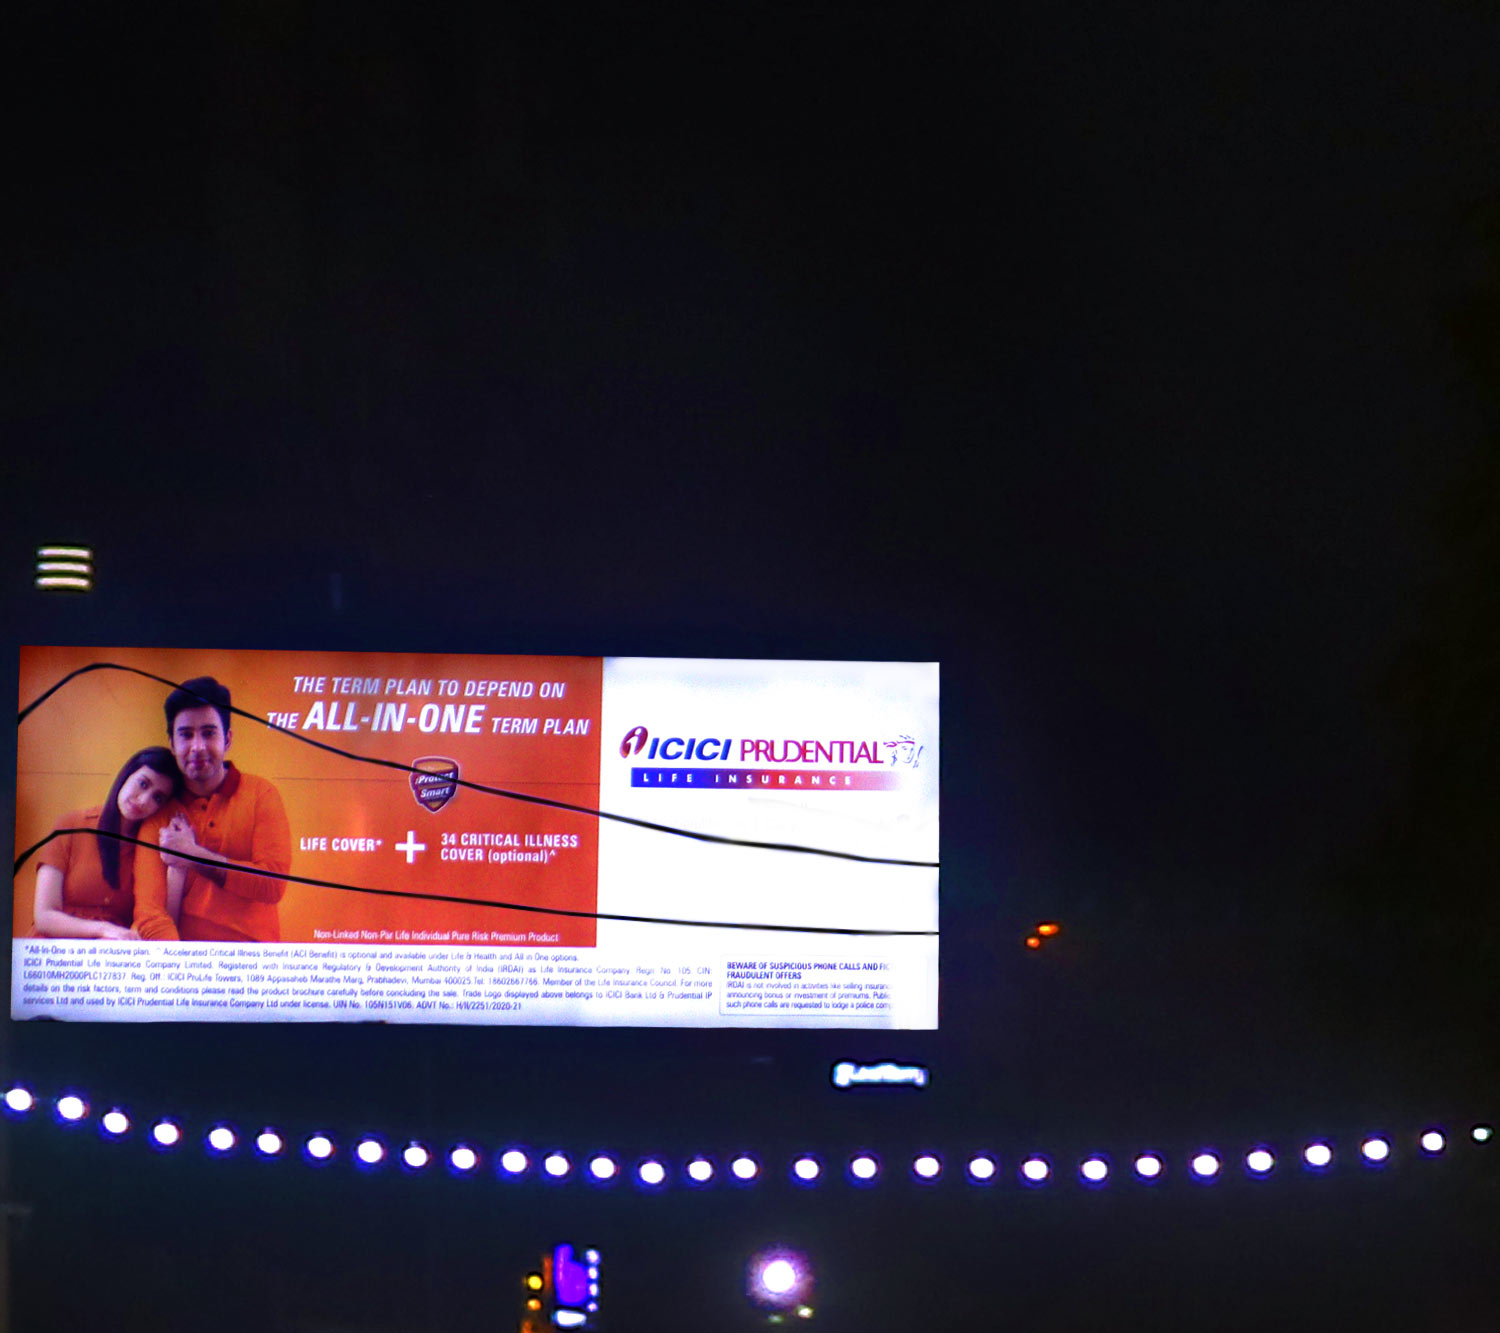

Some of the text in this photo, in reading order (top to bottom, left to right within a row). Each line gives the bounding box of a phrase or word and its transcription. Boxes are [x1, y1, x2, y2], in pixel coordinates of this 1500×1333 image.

[293, 676, 565, 698] THE TERM PLAN TO DEPEND ON
[266, 700, 590, 736] THE ALL-IN-ONE TERM PLAN
[648, 737, 884, 763] ICICI PRUDENTIAL
[643, 773, 852, 787] LIFE INSURANCE
[420, 786, 450, 798] Smart
[300, 837, 327, 851] LIFE
[440, 833, 579, 848] 34 CRITICAL ILLNESS
[440, 848, 483, 861] COVER
[313, 929, 358, 939] Non-Linked
[360, 930, 392, 940] Non-Par
[411, 930, 449, 940] Individual
[490, 931, 526, 941] Premium
[528, 932, 559, 942] Product
[726, 961, 756, 971] BEWARE
[769, 961, 811, 971] SUSPICIOUS
[813, 962, 836, 972] PHONE
[838, 962, 860, 972] CALLS
[726, 970, 802, 980] FRAUDULENT OFFERS
